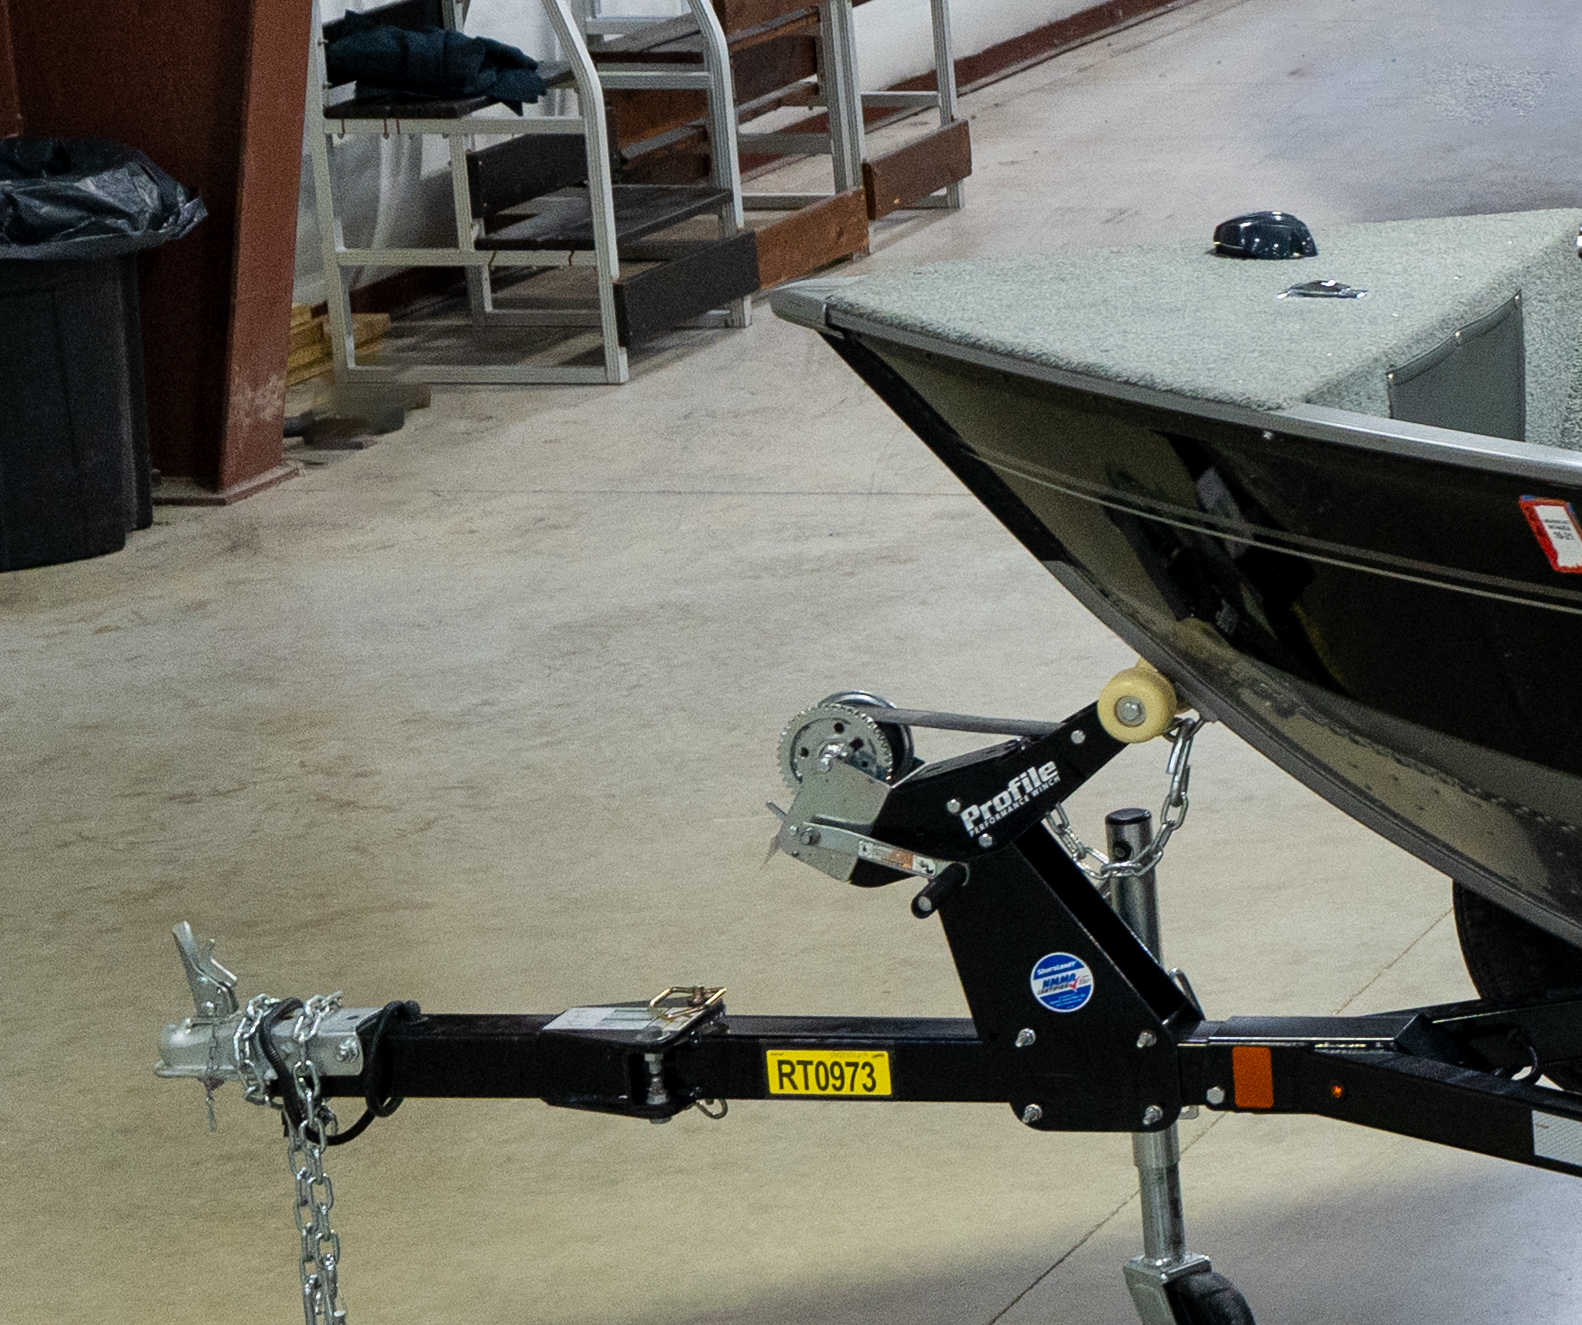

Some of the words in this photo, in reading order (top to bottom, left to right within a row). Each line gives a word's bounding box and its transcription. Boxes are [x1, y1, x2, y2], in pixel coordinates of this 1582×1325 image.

[960, 760, 1060, 831] Profile
[969, 791, 1030, 838] PERFORMANCE
[1032, 775, 1061, 798] WINCH
[777, 1059, 877, 1092] RT0973
